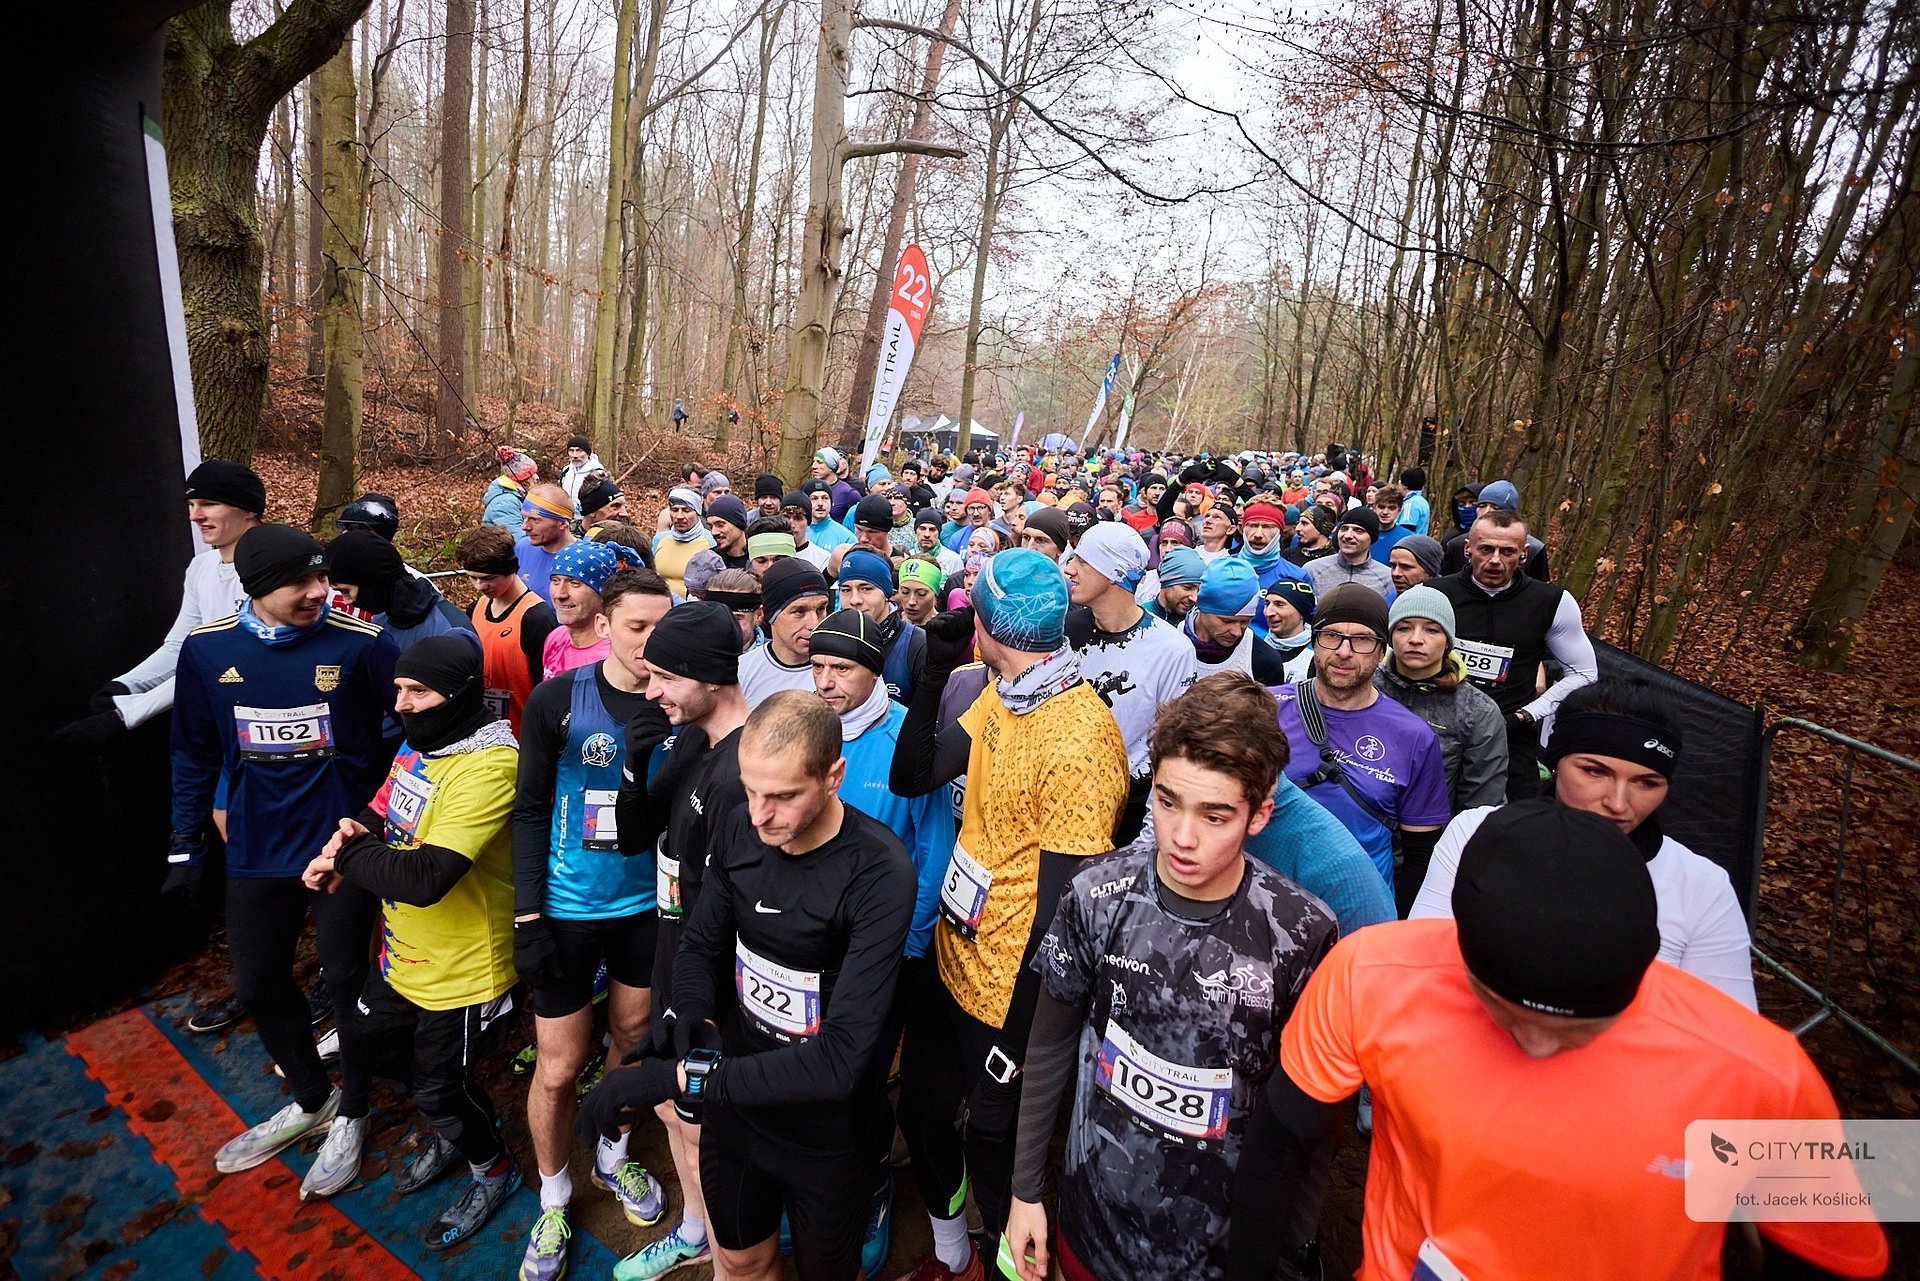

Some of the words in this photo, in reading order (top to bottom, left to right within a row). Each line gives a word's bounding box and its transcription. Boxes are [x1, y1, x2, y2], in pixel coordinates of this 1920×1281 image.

[898, 263, 928, 309] 22
[1460, 652, 1492, 671] 158
[255, 723, 312, 741] 1162
[391, 786, 414, 817] 1174
[948, 869, 961, 893] 5
[749, 976, 793, 1016] 222
[1119, 1059, 1205, 1119] 1028
[442, 1222, 465, 1244] CR7
